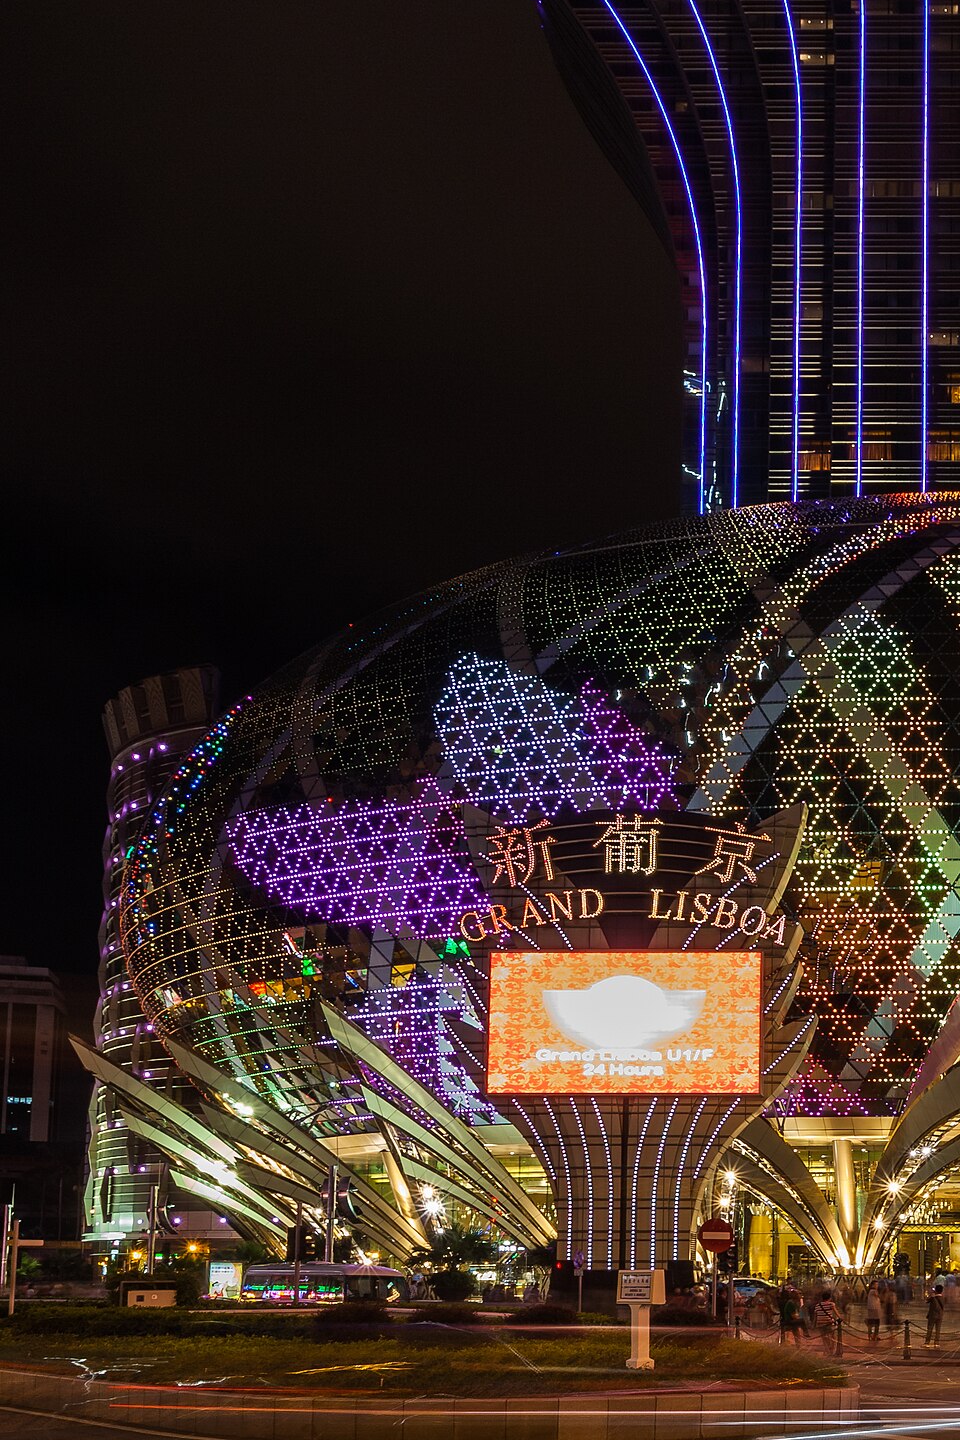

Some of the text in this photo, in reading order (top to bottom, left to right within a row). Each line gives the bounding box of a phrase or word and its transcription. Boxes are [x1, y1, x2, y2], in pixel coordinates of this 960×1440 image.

[486, 813, 772, 888] 新葡京
[459, 888, 787, 946] GRAND LISBOA
[535, 1048, 595, 1062] Grand
[666, 1048, 714, 1062] U1/F
[582, 1063, 664, 1076] 24 Hours
